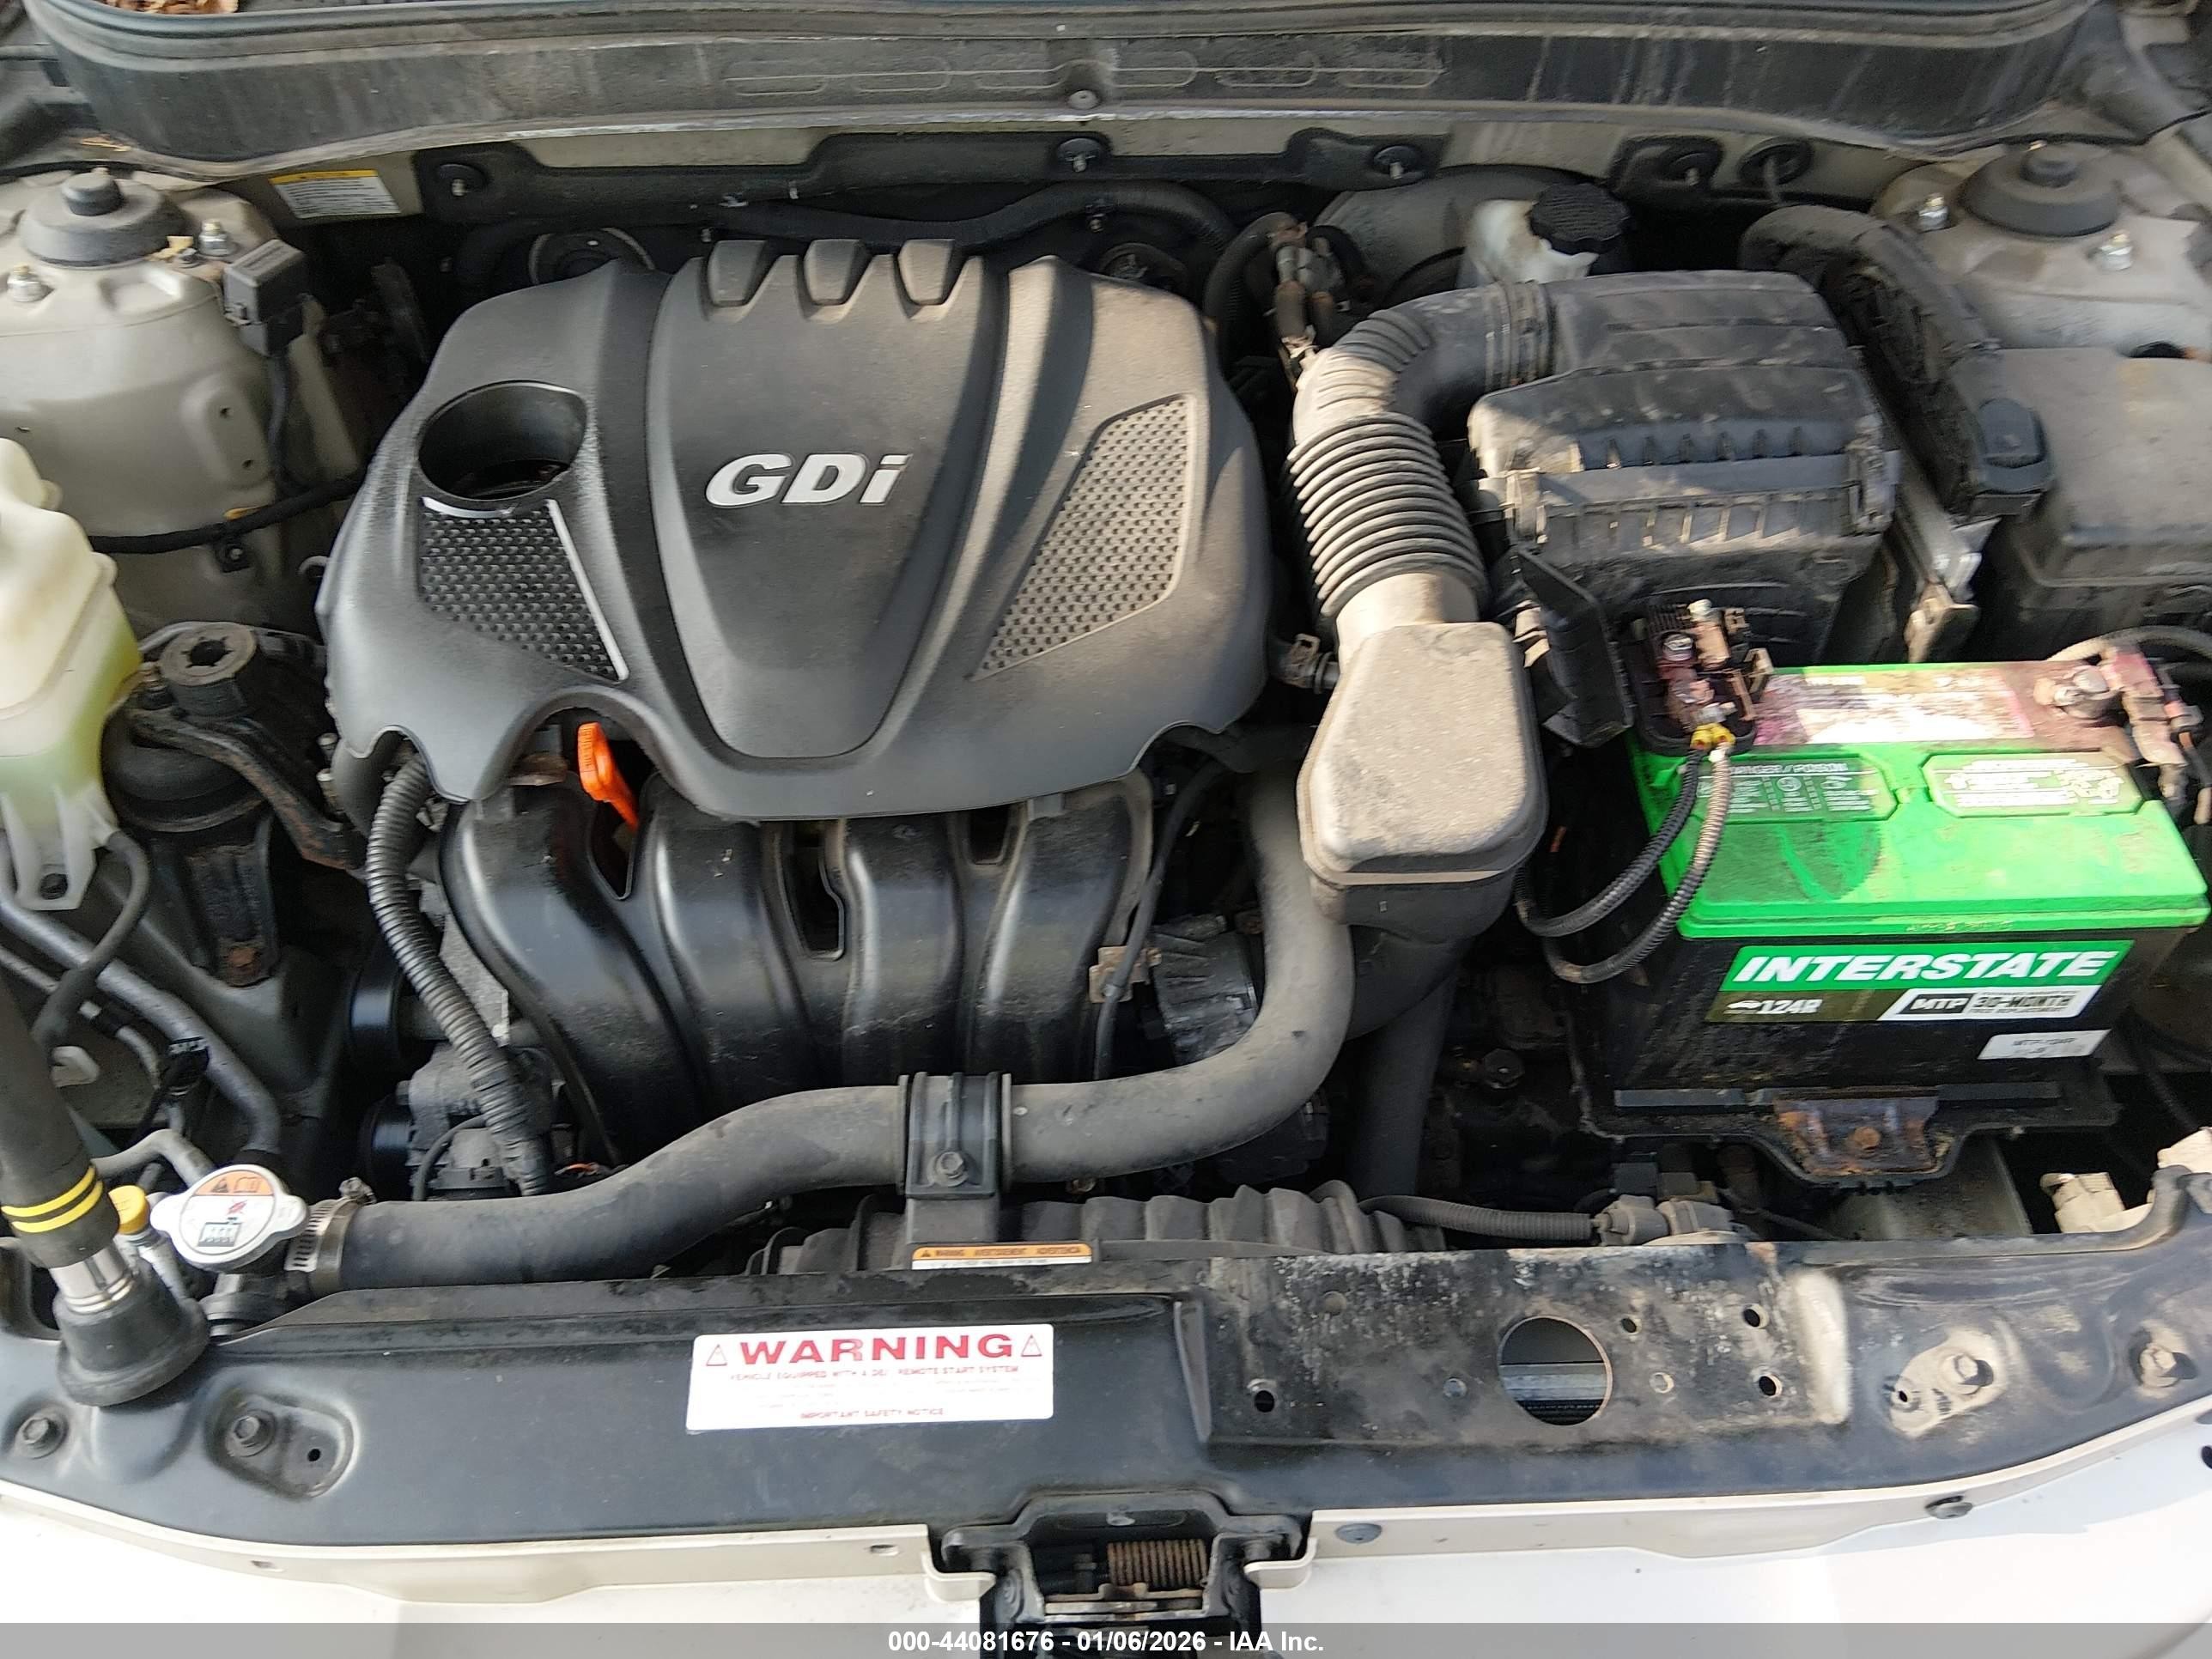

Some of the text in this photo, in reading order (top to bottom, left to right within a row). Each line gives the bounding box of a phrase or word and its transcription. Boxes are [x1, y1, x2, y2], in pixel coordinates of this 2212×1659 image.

[705, 453, 913, 507] GDi
[1733, 950, 2119, 982] INTERSTATE
[739, 1334, 1013, 1365] WARNING
